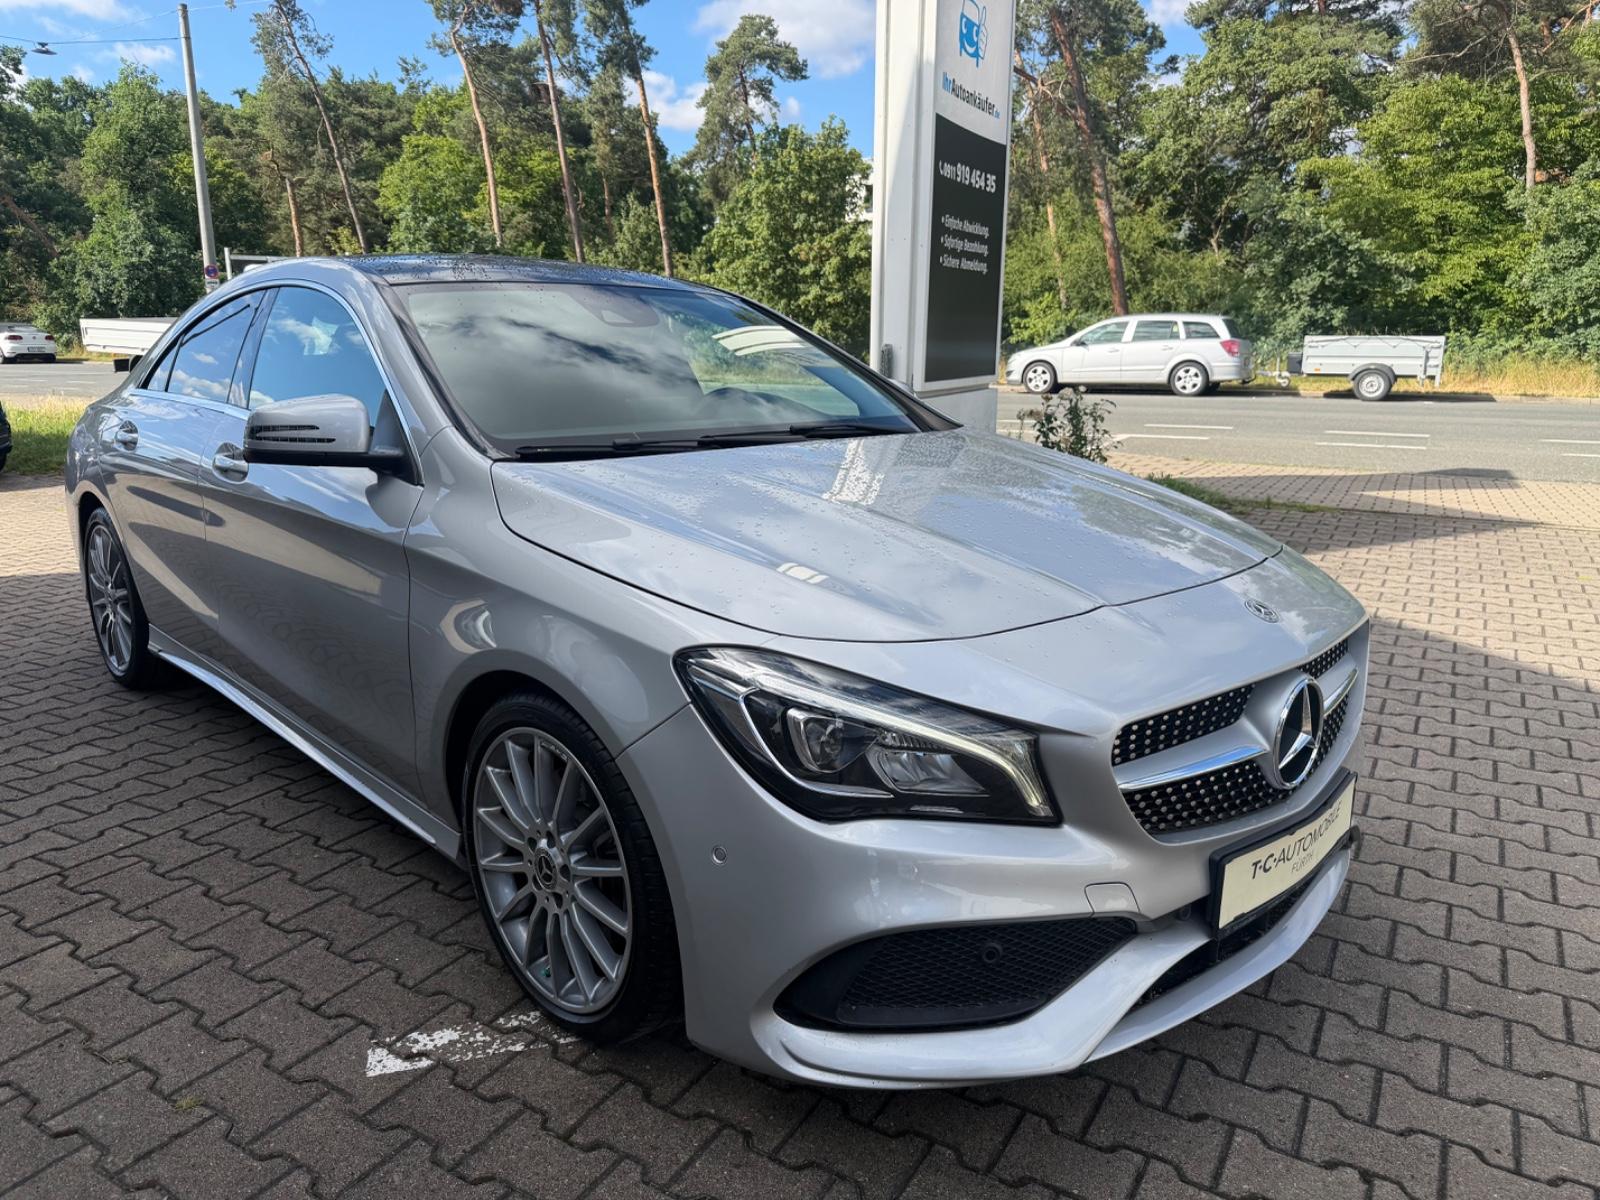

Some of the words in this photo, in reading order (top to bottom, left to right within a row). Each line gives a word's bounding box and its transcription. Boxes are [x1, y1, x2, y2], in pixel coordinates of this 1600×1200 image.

[944, 162, 956, 180] 0911
[957, 163, 970, 185] 919
[971, 168, 985, 190] 454
[986, 174, 997, 193] 35
